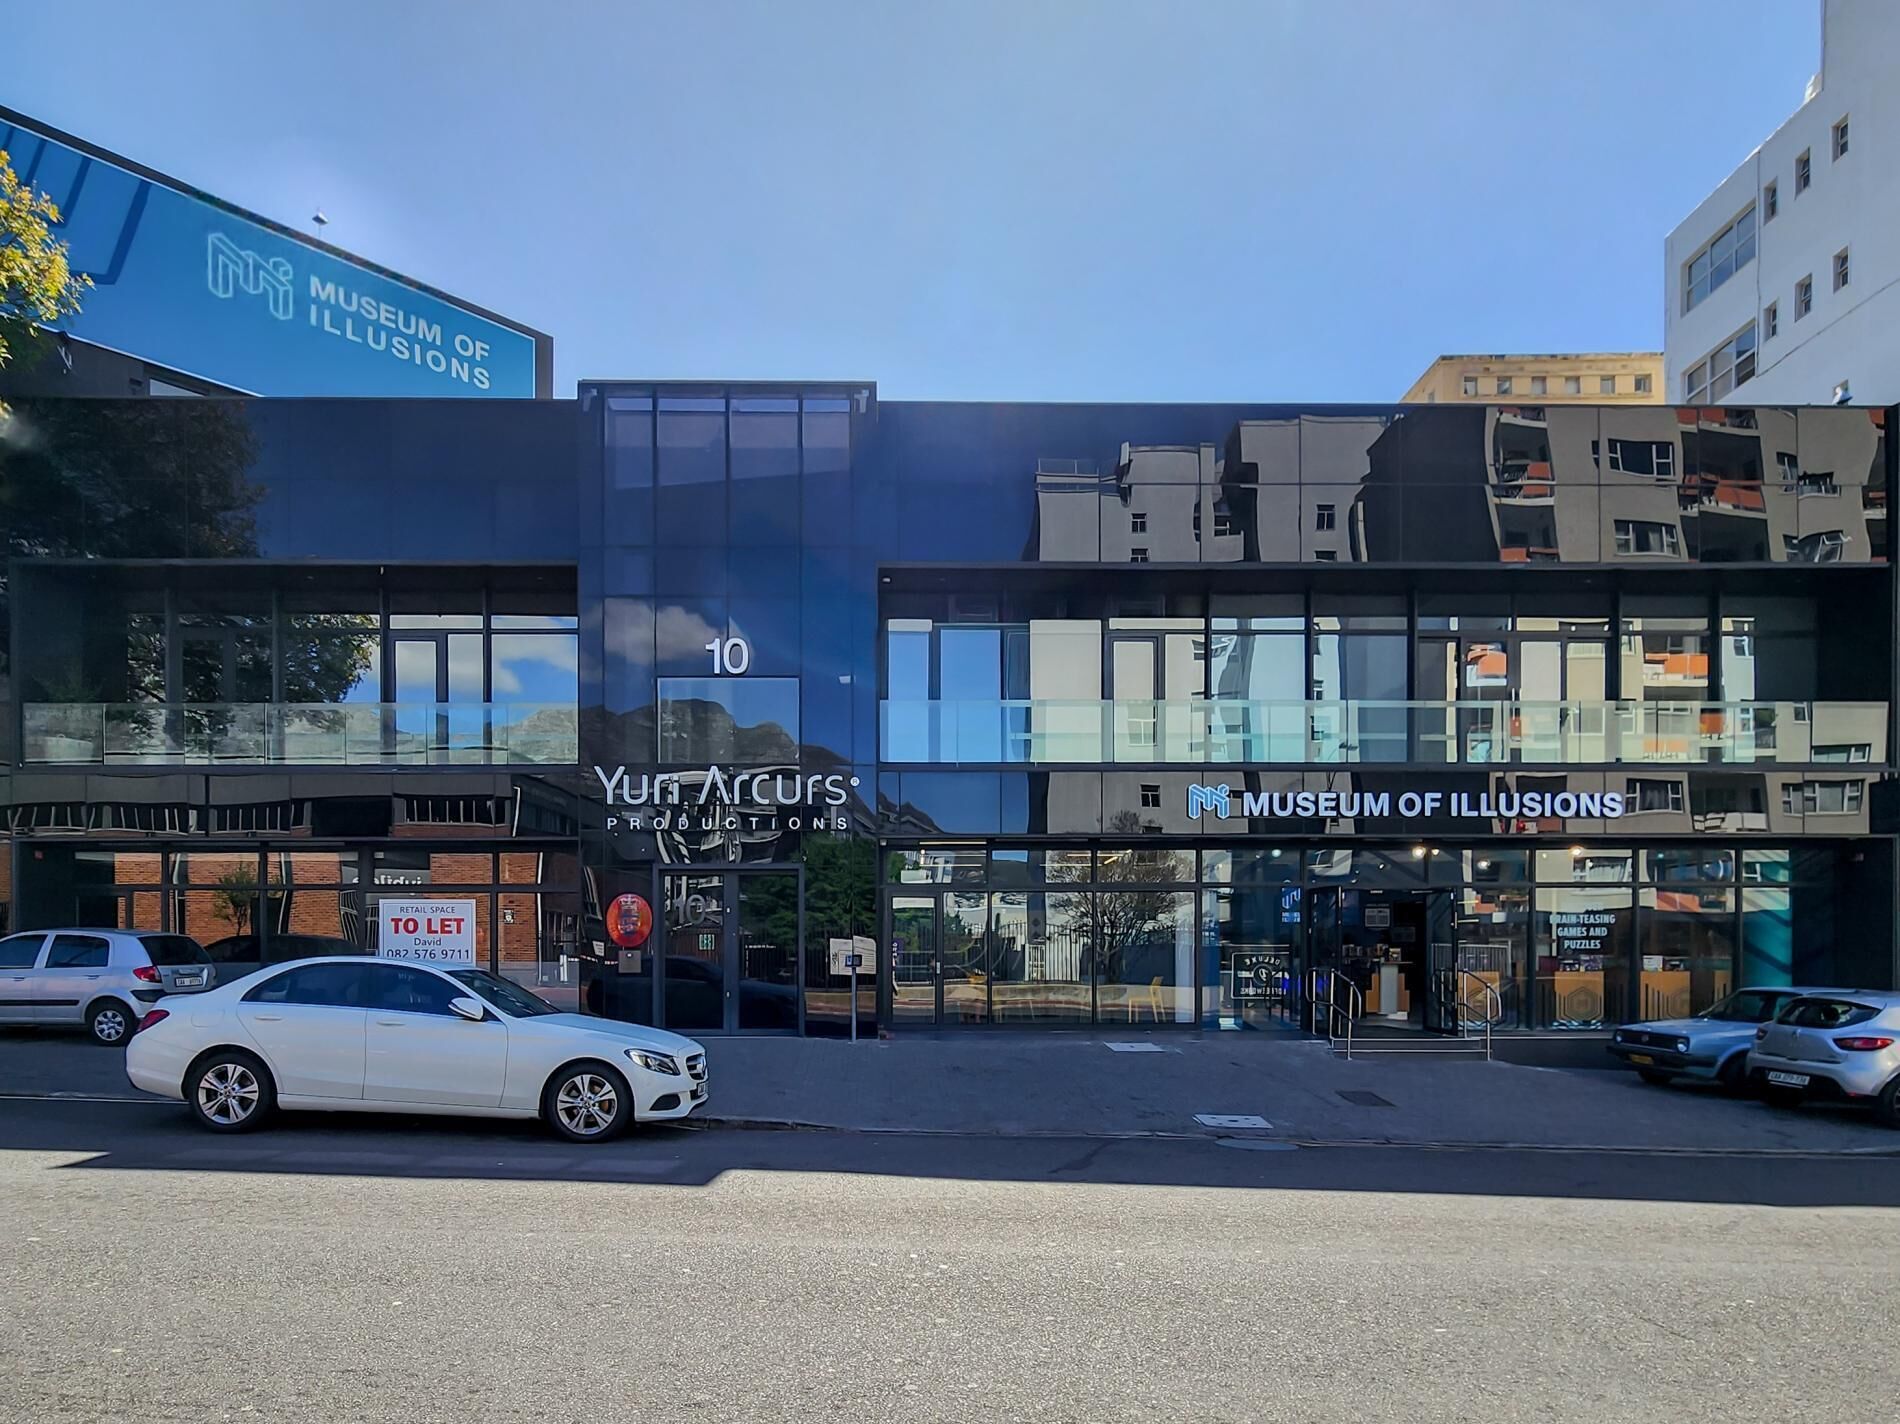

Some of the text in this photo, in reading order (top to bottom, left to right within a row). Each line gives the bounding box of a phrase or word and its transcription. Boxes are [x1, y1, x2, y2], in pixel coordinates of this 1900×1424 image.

[310, 275, 491, 362] MUSEUM OF
[310, 304, 491, 391] ILLUSIONS
[705, 637, 750, 675] 10
[594, 765, 680, 806] Yuri
[1243, 792, 1625, 818] MUSEUM OF ILLUSIONS
[606, 817, 848, 831] PRODUCTIONS
[400, 906, 456, 914] RETAIL SPACE
[390, 917, 465, 935] TO LET
[1549, 914, 1616, 924] BRAIN-TEASING
[1557, 927, 1608, 937] GAMES AND
[414, 937, 442, 946] David
[1563, 940, 1601, 949] PUZZLES
[386, 949, 469, 960] 082 576 9711
